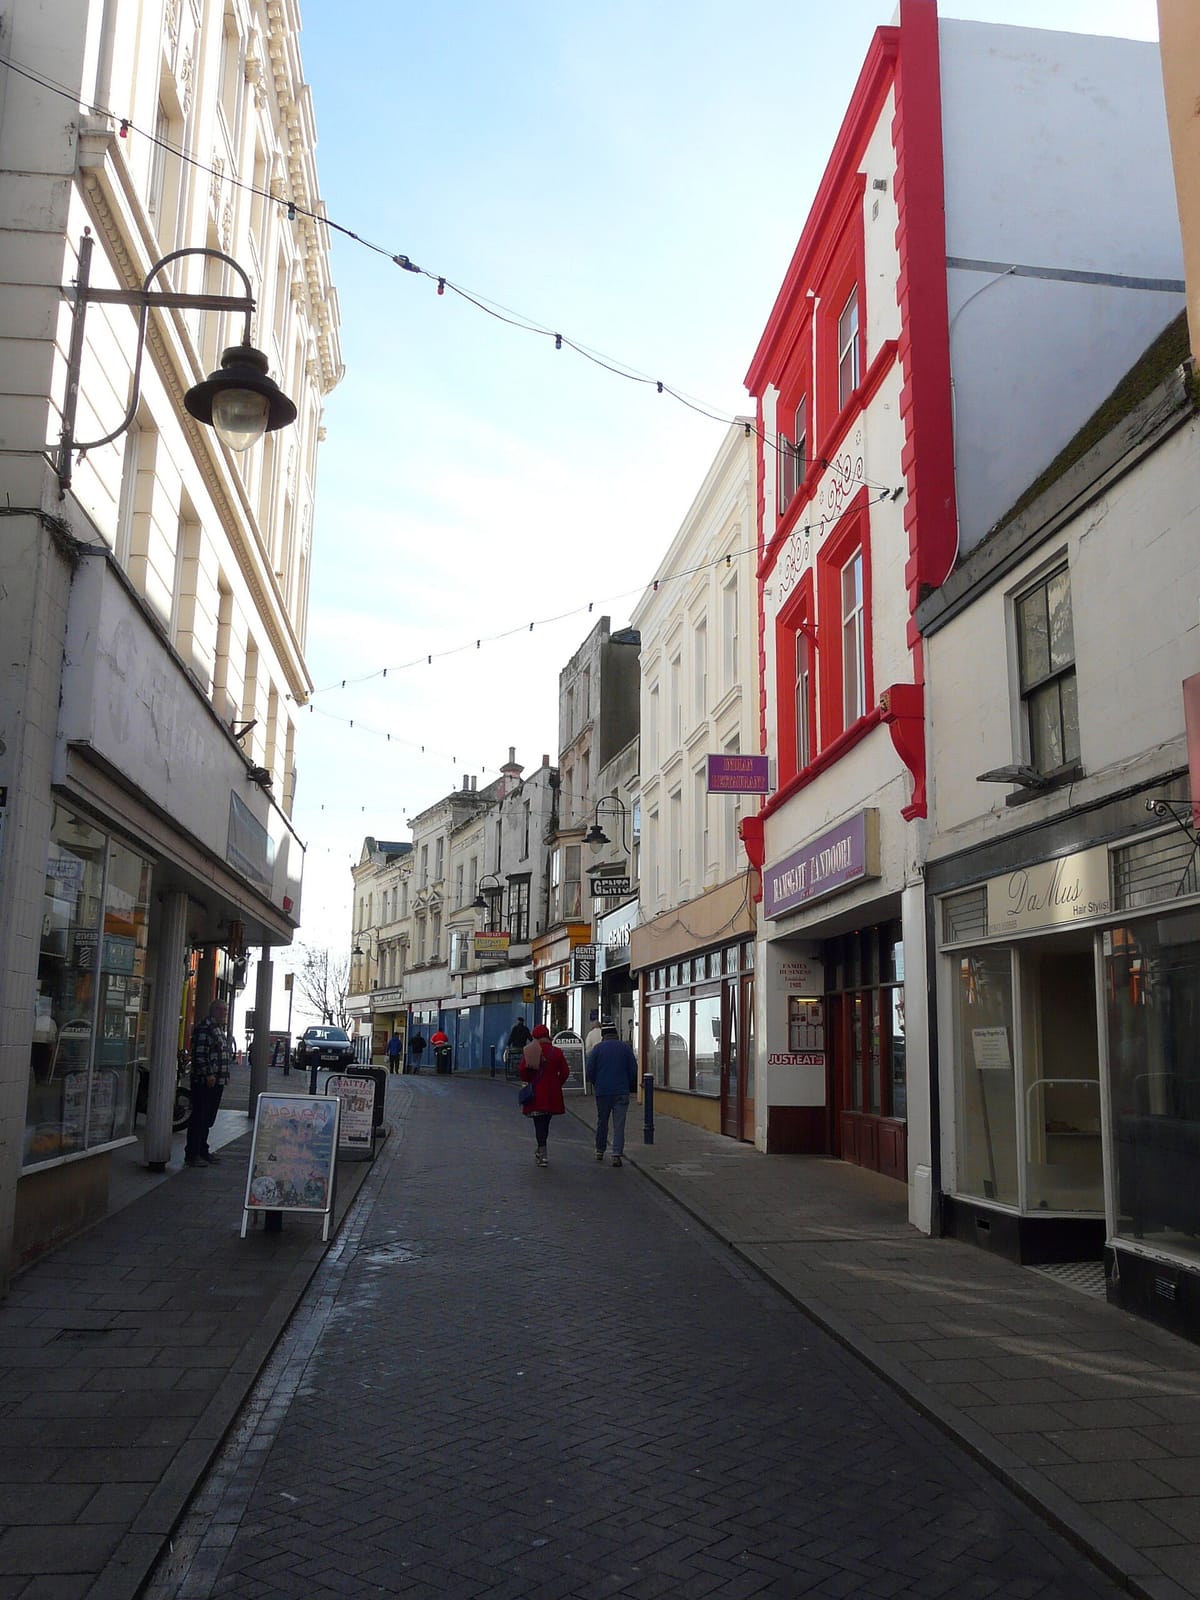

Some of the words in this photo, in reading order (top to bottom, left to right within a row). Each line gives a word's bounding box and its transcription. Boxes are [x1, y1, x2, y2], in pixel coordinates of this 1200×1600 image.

[722, 758, 753, 771] INDIAN
[773, 861, 807, 904] RAMSGATE
[809, 835, 852, 885] TANDOORI
[593, 879, 630, 895] GENTS
[1072, 903, 1087, 916] Hair
[608, 923, 631, 952] GENTS
[768, 1054, 796, 1065] JUST
[796, 1054, 816, 1065] EAT
